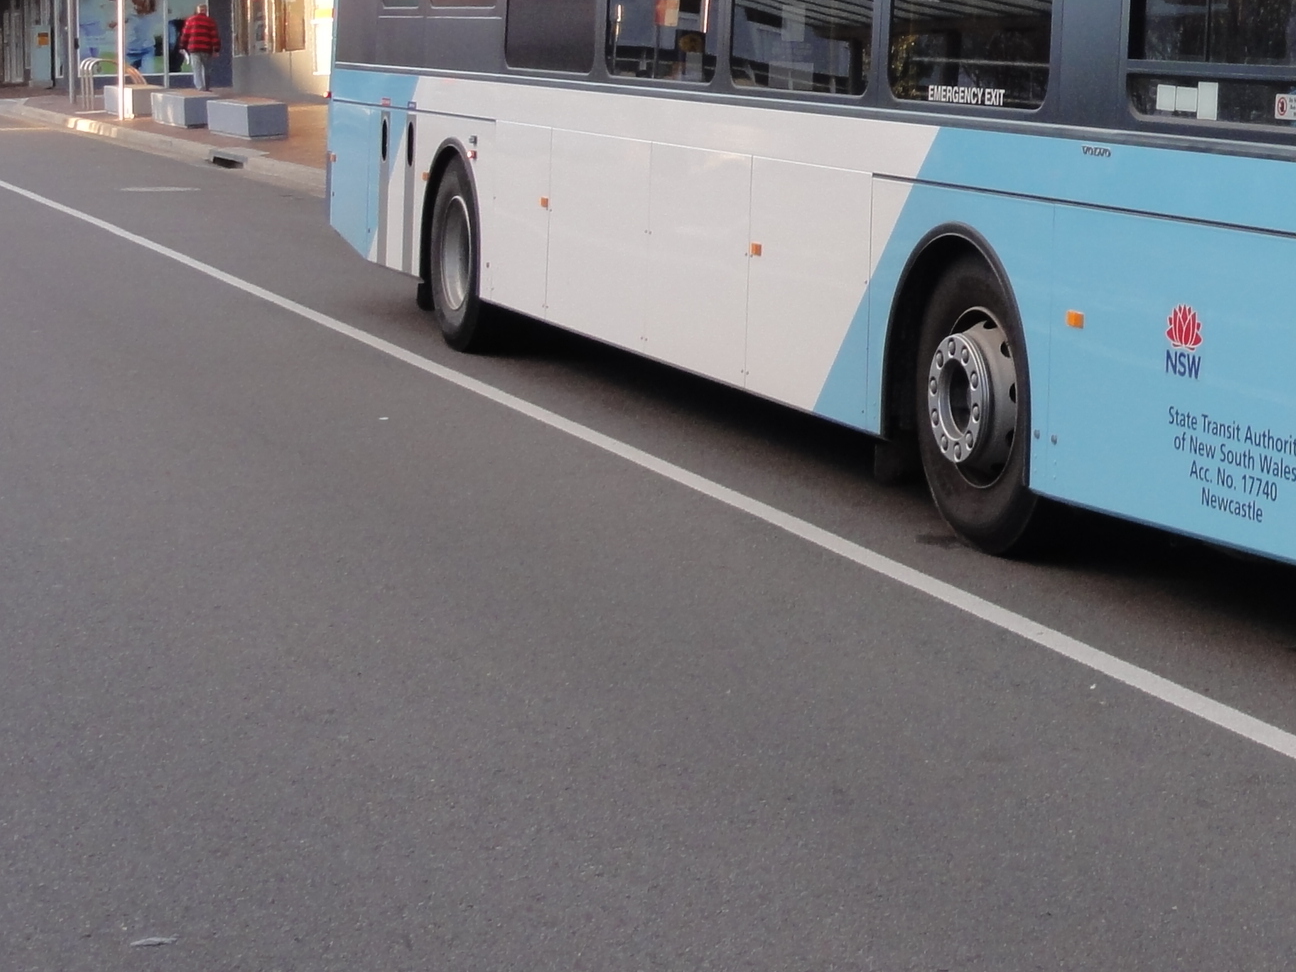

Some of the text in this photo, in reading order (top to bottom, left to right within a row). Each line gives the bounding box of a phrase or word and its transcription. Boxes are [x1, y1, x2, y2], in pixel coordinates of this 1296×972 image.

[928, 84, 1006, 107] EMERGENCY EXIT
[1081, 145, 1112, 158] VOLVO
[1166, 349, 1201, 379] NSW
[1168, 405, 1198, 431] State
[1201, 414, 1241, 443] Transit
[1173, 431, 1187, 452] of
[1189, 437, 1217, 460] New
[1219, 443, 1255, 471] South
[1189, 460, 1278, 502] Acc. No. 17740
[1201, 486, 1264, 524] Newcastle
